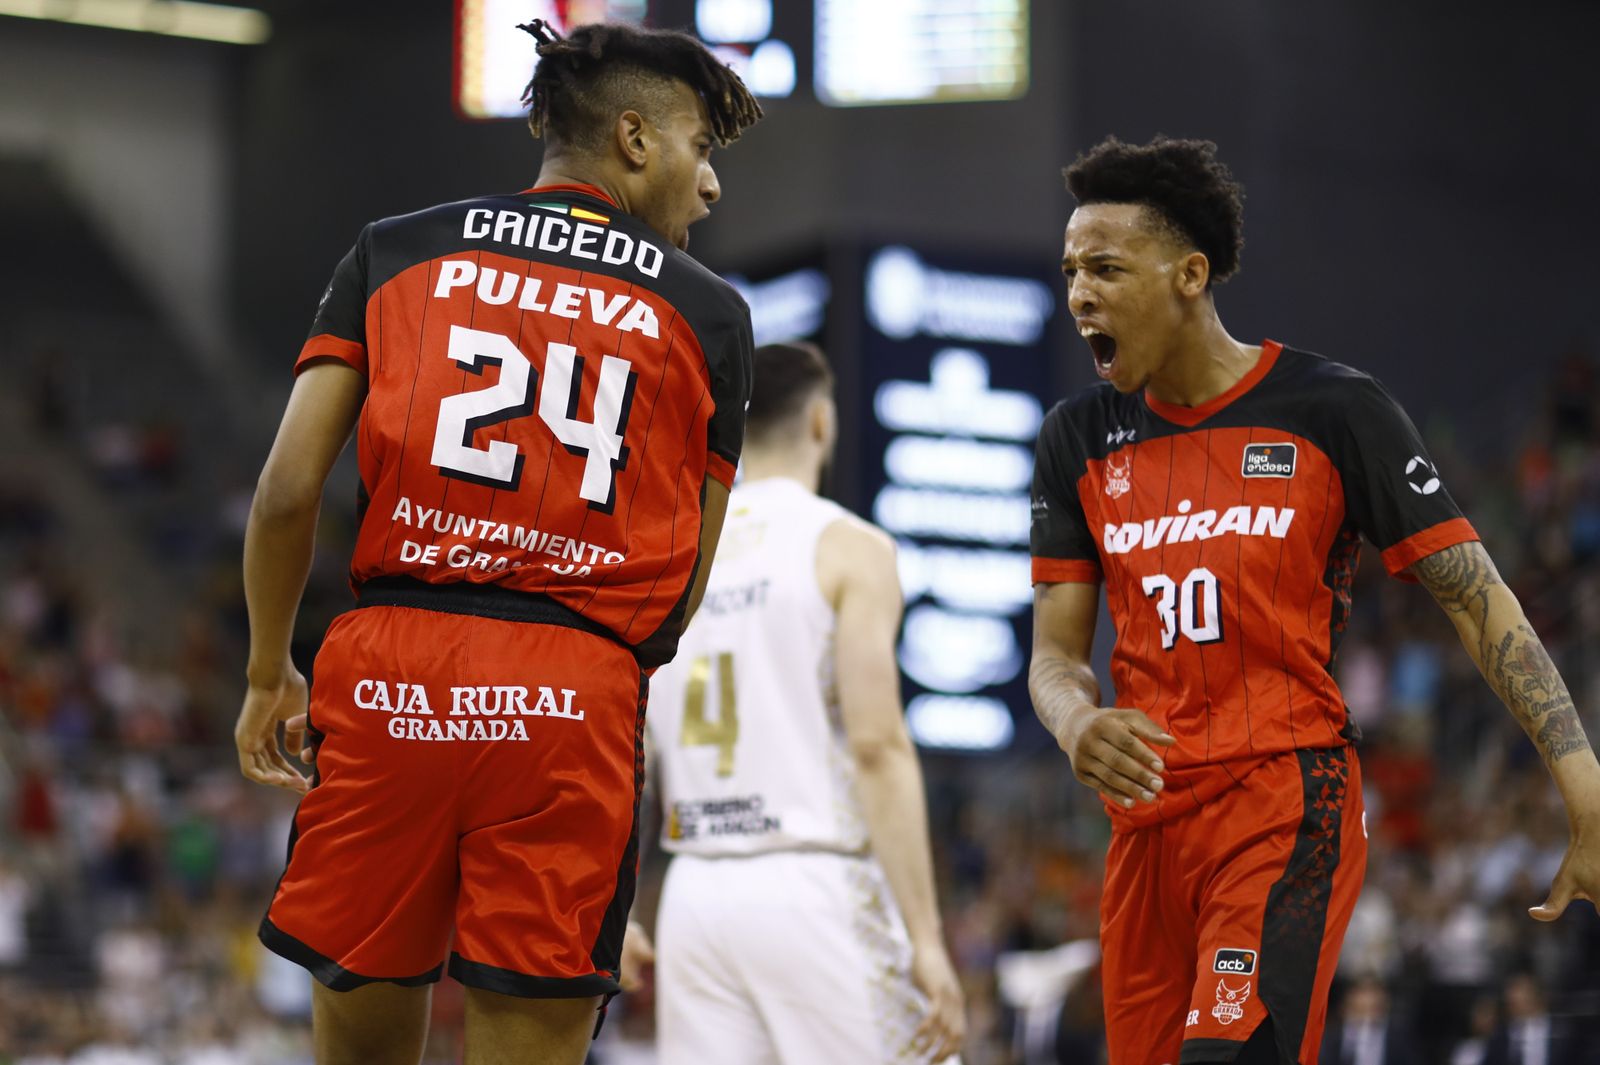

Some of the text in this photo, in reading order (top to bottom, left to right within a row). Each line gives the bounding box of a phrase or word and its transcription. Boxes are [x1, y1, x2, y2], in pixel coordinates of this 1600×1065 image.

[462, 208, 664, 279] CAICEDO
[433, 260, 660, 339] PULEVA
[430, 324, 638, 515] 24
[1247, 462, 1291, 473] endesa
[391, 496, 626, 565] AYUNTAMIENTO
[399, 540, 441, 566] DE
[1141, 566, 1225, 652] 30
[353, 679, 585, 721] CAJA RURAL
[388, 716, 530, 742] GRANADA
[680, 652, 739, 778] 4
[1217, 958, 1245, 971] acb
